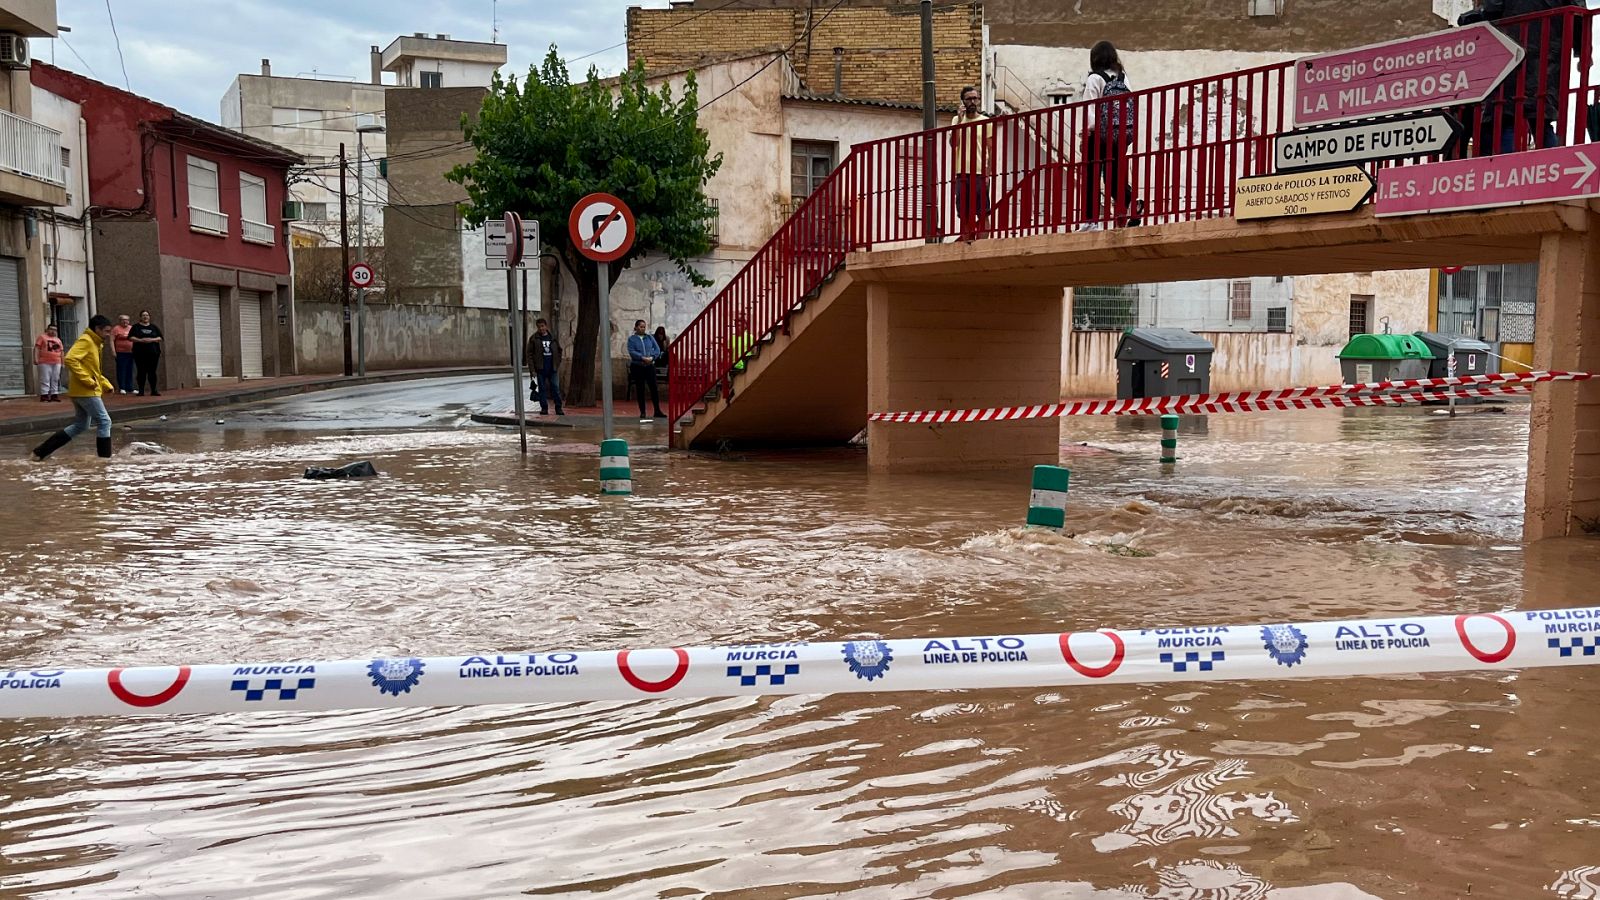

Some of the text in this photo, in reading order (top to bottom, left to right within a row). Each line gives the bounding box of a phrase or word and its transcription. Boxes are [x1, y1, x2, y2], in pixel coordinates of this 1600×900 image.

[1304, 40, 1476, 84] Colegio Concertado
[1303, 70, 1469, 115] LA MILAGROSA
[1283, 125, 1437, 160] CAMPO DE FUTBOL
[1236, 172, 1364, 195] ASADERO de POLLOS LA TORRE
[1379, 163, 1561, 200] I.E.S. JOSÉ PLANES
[1245, 189, 1351, 207] ABIERTO SABADOS Y FESTIVOS
[1284, 205, 1299, 215] 500
[354, 271, 369, 280] 30
[1335, 623, 1425, 638] ALTO
[923, 637, 1025, 652] ALTO
[1158, 636, 1223, 648] MURCIA
[1336, 637, 1430, 651] LINEA DE POLICIA
[460, 653, 579, 666] ALTO
[726, 649, 798, 661] MURCIA
[924, 650, 1028, 664] LINEA DE POLICIA
[233, 665, 315, 676] MURCIA
[459, 664, 579, 678] LINEA DE POLICIA
[0, 678, 61, 689] POLICIA
